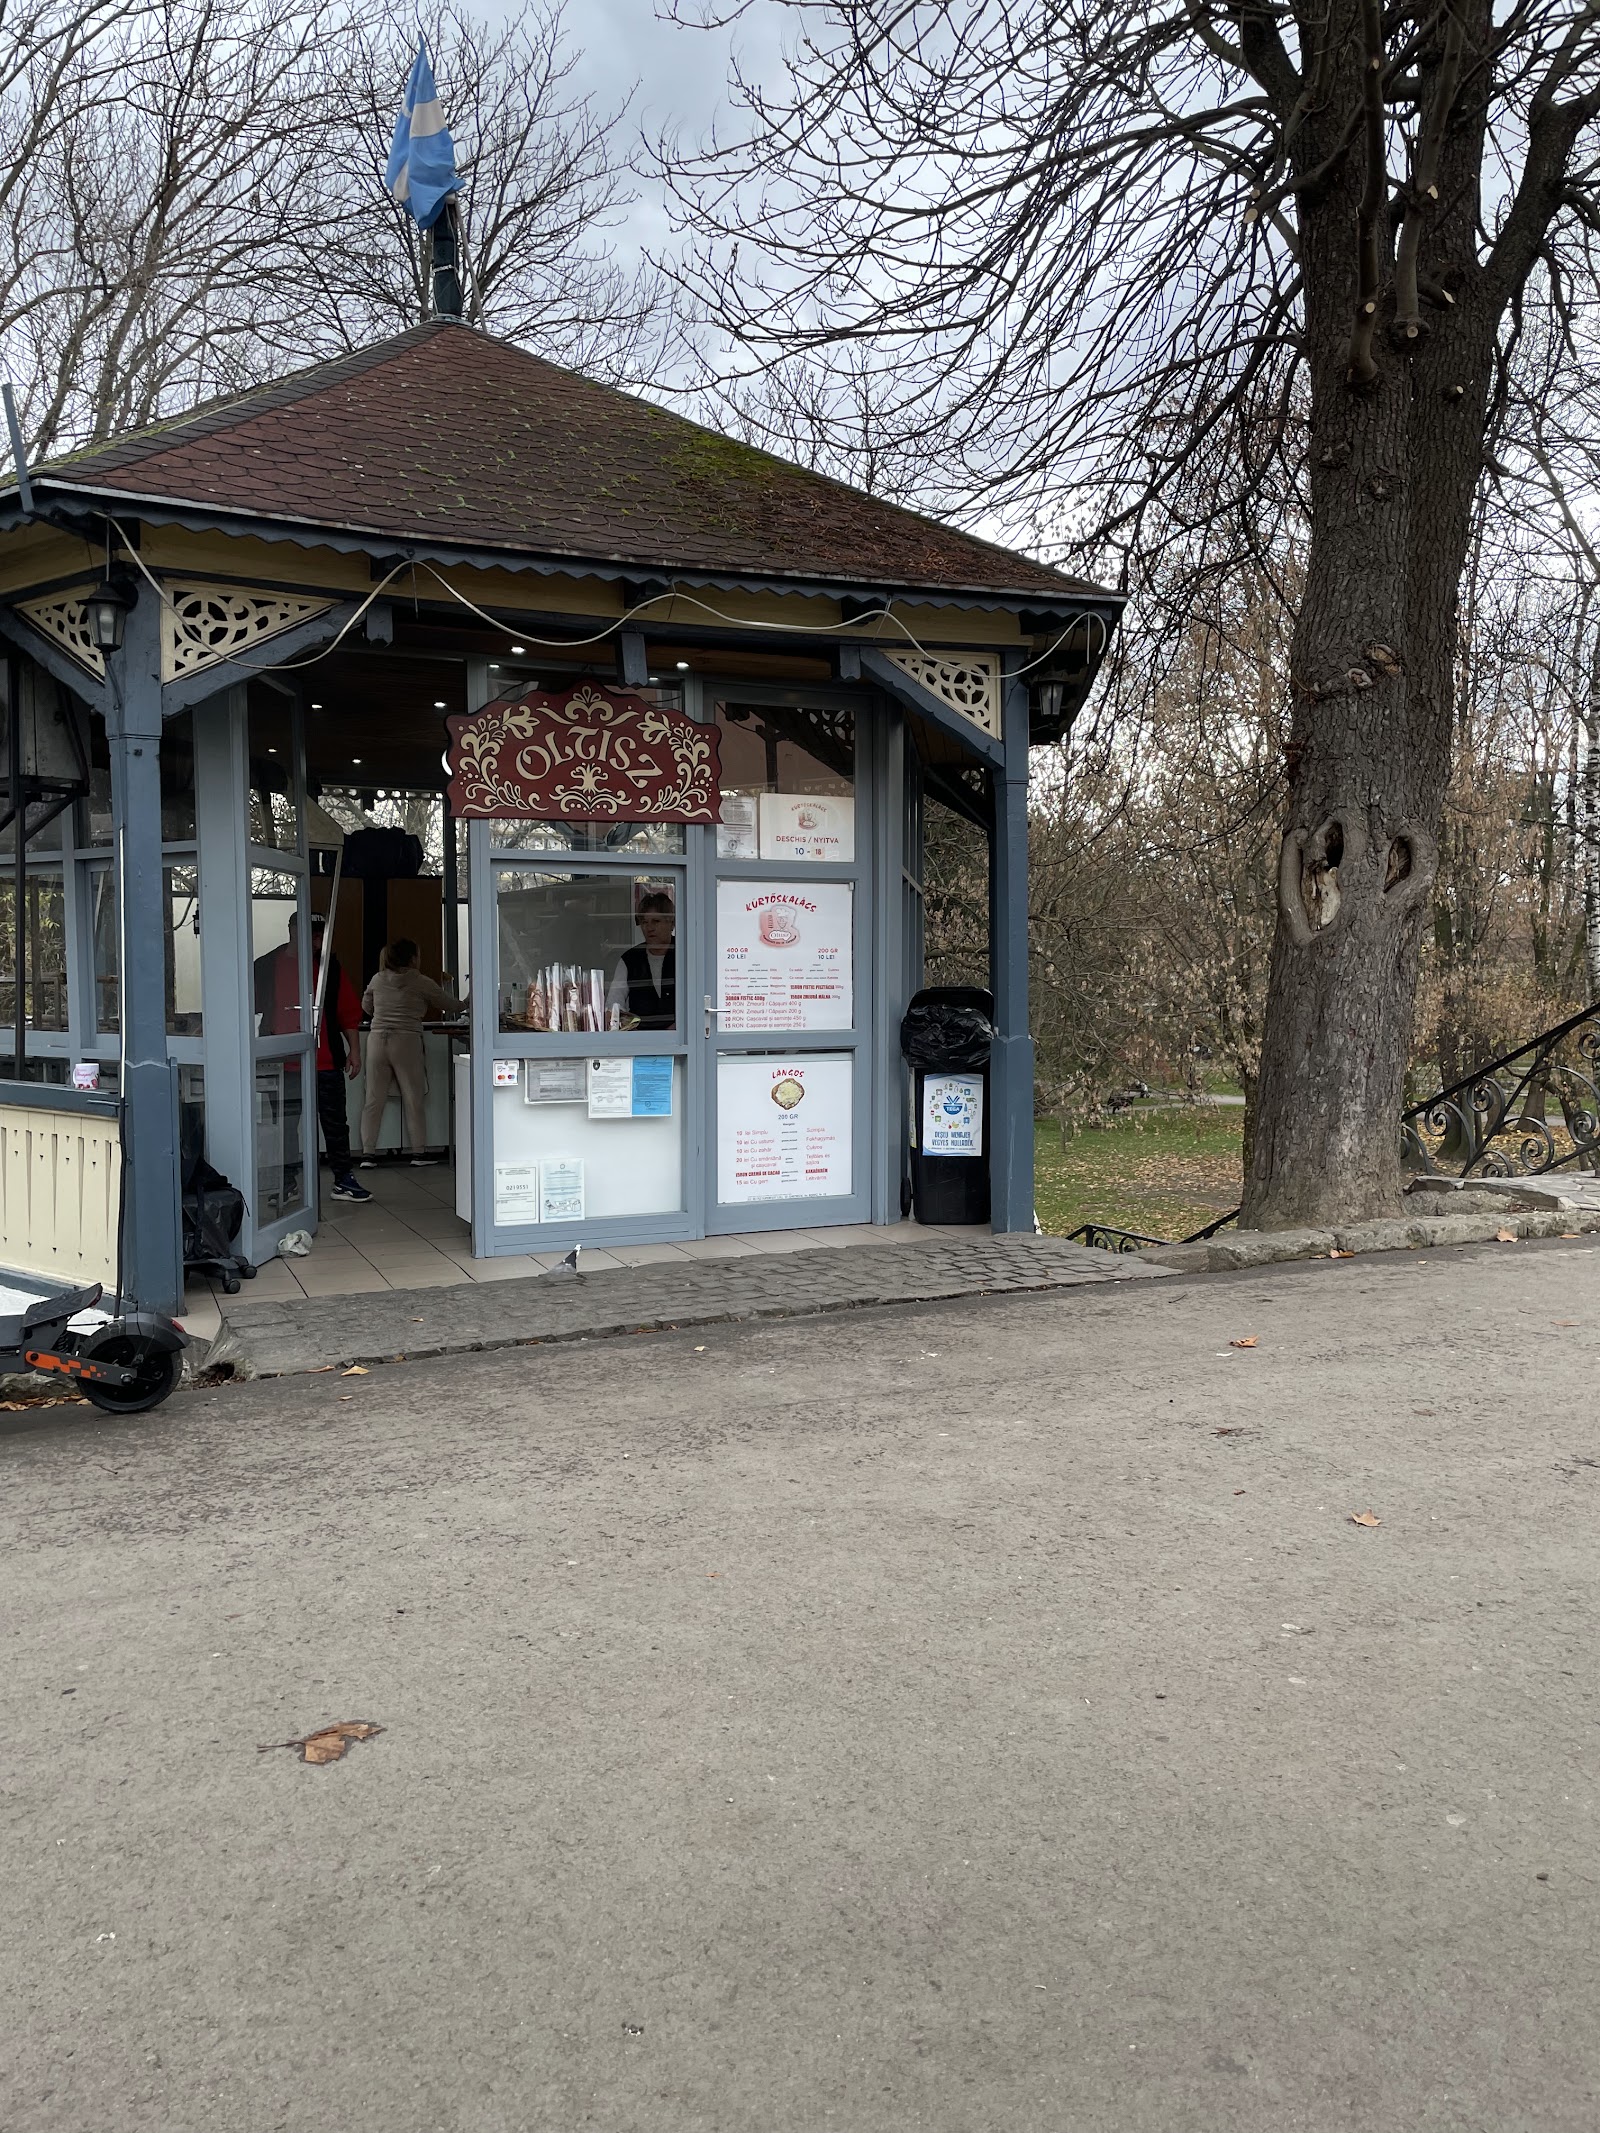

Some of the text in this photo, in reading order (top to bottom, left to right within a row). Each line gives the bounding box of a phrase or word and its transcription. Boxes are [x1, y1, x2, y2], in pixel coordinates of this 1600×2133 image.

[515, 725, 664, 789] OLTISZ
[776, 835, 807, 843] DESCHIS
[807, 836, 811, 844] /
[795, 847, 805, 855] 10
